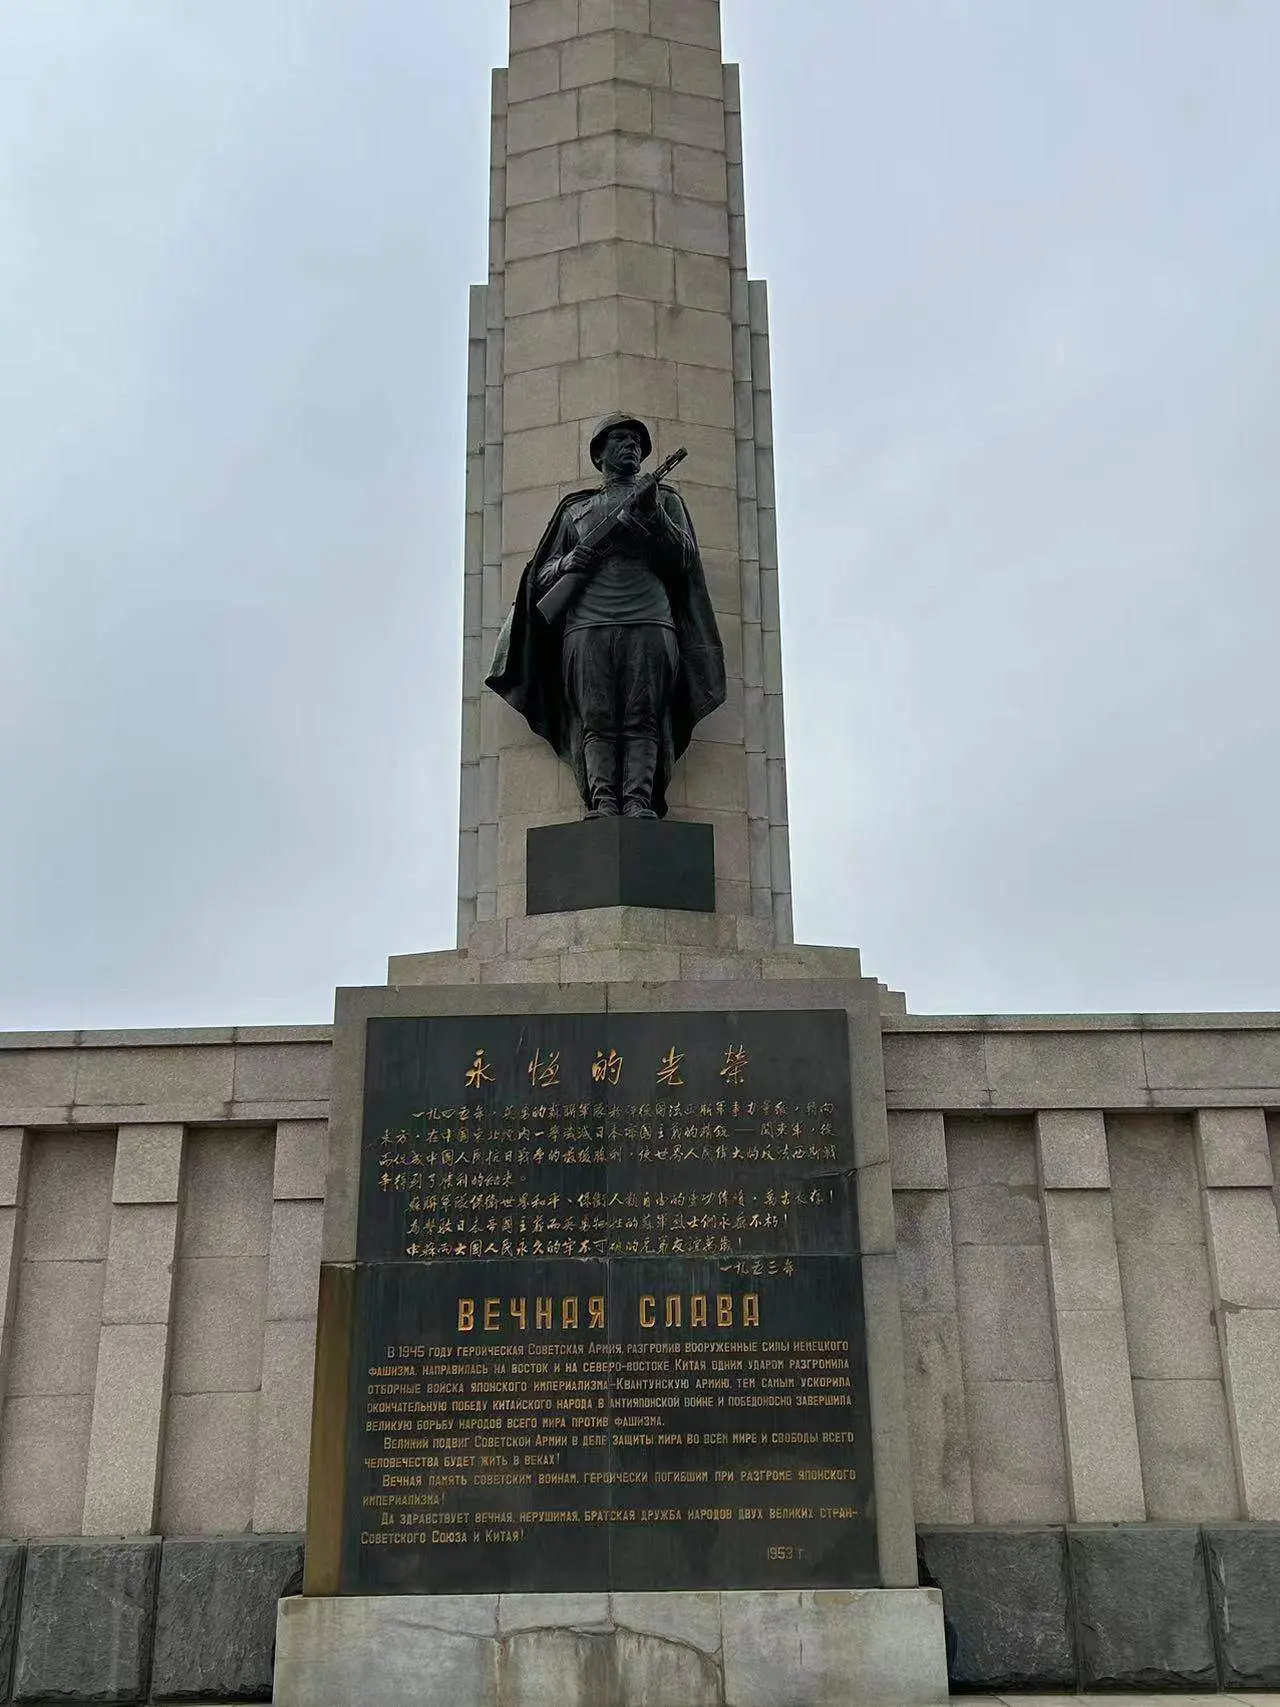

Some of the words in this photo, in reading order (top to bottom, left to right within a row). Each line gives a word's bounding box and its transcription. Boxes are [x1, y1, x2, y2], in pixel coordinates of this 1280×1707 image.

[720, 1258, 798, 1277] 一九五三年
[458, 1297, 605, 1331] ВЕЧНАЯ
[639, 1293, 760, 1328] СЛАВА
[388, 1347, 395, 1358] В
[399, 1346, 425, 1358] 1945
[429, 1347, 451, 1357] ГОДУ
[457, 1346, 524, 1356] ГЕРОИЧЕСКАЯ
[528, 1343, 584, 1354] СОВЕТСКАЯ
[627, 1343, 681, 1353] РАЗГРОМИВ
[685, 1342, 757, 1353] ВООРУЖЕННЫЕ
[762, 1342, 790, 1351] СИЛЫ
[793, 1341, 849, 1351] НЕМЕЦКОГО
[422, 1365, 489, 1375] НАПРАВИЛАСЬ
[494, 1364, 506, 1374] НА
[512, 1364, 547, 1373] ВОСТОК
[554, 1363, 560, 1372] И
[565, 1363, 577, 1373] НА
[583, 1362, 670, 1372] СЕВЕРО-ВОСТОКЕ
[675, 1359, 706, 1371] КИТАЯ
[712, 1360, 743, 1371] ОДНИМ
[748, 1360, 784, 1370] УДАРОМ
[789, 1358, 849, 1369] РАЗГРОМИЛА
[368, 1384, 421, 1395] ОТБОРНЫЕ
[427, 1382, 464, 1393] ВОЙСКА
[471, 1382, 527, 1392] ЯПОНСКОГО
[737, 1378, 756, 1388] ТЕМ
[761, 1378, 795, 1388] САМЫМ
[800, 1376, 850, 1387] УСКОРИЛА
[367, 1401, 447, 1413] ОКОНЧАТЕЛЬНУЮ
[452, 1401, 487, 1411] ПОБЕДУ
[493, 1398, 551, 1410] КИТАЙСКОГО
[556, 1399, 592, 1410] НАРОДА
[598, 1399, 604, 1408] В
[609, 1395, 680, 1408] АНТИЯПОНСКОЙ
[684, 1395, 713, 1407] ВОЙНЕ
[718, 1396, 724, 1406] И
[729, 1395, 791, 1406] ПОБЕДОНОСНО
[797, 1394, 852, 1406] ЗАВЕРШИЛА
[366, 1420, 412, 1432] ВЕЛИКУЮ
[417, 1419, 452, 1430] БОРЬБУ
[459, 1419, 502, 1429] НАРОДОВ
[507, 1418, 536, 1428] ВСЕГО
[542, 1418, 566, 1428] МИРА
[571, 1417, 609, 1427] ПРОТИВ
[615, 1416, 665, 1427] ФАШИЗМА.
[384, 1435, 428, 1449] ВЕЛИКИЙ
[432, 1436, 468, 1448] ПОДВИГ
[474, 1434, 530, 1447] СОВЕТСКОЙ
[535, 1435, 567, 1446] АРМИИ
[572, 1435, 578, 1446] В
[583, 1435, 607, 1446] ДЕЛЕ
[612, 1435, 653, 1446] ЗАЩИТЫ
[658, 1434, 682, 1444] МИРА
[687, 1433, 700, 1444] ВО
[704, 1433, 728, 1443] ВСЕМ
[733, 1433, 757, 1443] МИРЕ
[761, 1433, 768, 1442] И
[772, 1432, 818, 1443] СВОБОДЫ
[823, 1431, 854, 1442] ВСЕГО
[365, 1457, 439, 1468] ЧЕЛОВЕЧЕСТВА
[444, 1457, 474, 1467] БУДЕТ
[480, 1456, 508, 1466] ЖИТЬ
[514, 1456, 519, 1465] В
[525, 1453, 560, 1465] ВЕКАХ!
[383, 1474, 422, 1487] ВЕЧНАЯ
[429, 1475, 467, 1486] ПАМЯТЬ
[474, 1474, 531, 1485] СОВЕТСКИМ
[584, 1471, 648, 1483] ГЕРОИЧЕСКИ
[655, 1471, 707, 1482] ПОГИБШИМ
[715, 1471, 734, 1481] ПРИ
[741, 1470, 791, 1481] РАЗГРОМЕ
[799, 1470, 856, 1481] ЯПОНСКОГО
[363, 1494, 445, 1506] ИМПЕРИАЛИЗМА!
[381, 1513, 393, 1525] ДА
[400, 1513, 469, 1524] ЗДРАВСТВУЕТ
[585, 1509, 636, 1521] БРАТСКАЯ
[641, 1510, 681, 1521] ДРУЖБА
[688, 1510, 732, 1520] НАРОДОВ
[738, 1509, 763, 1520] ДВУХ
[770, 1508, 814, 1519] ВЕЛИКИХ
[361, 1530, 425, 1544] СОВЕТСКОГО
[432, 1529, 467, 1543] СОЮЗА
[474, 1531, 480, 1542] И
[485, 1527, 524, 1542] КИТАЯ!
[767, 1546, 793, 1560] 1953
